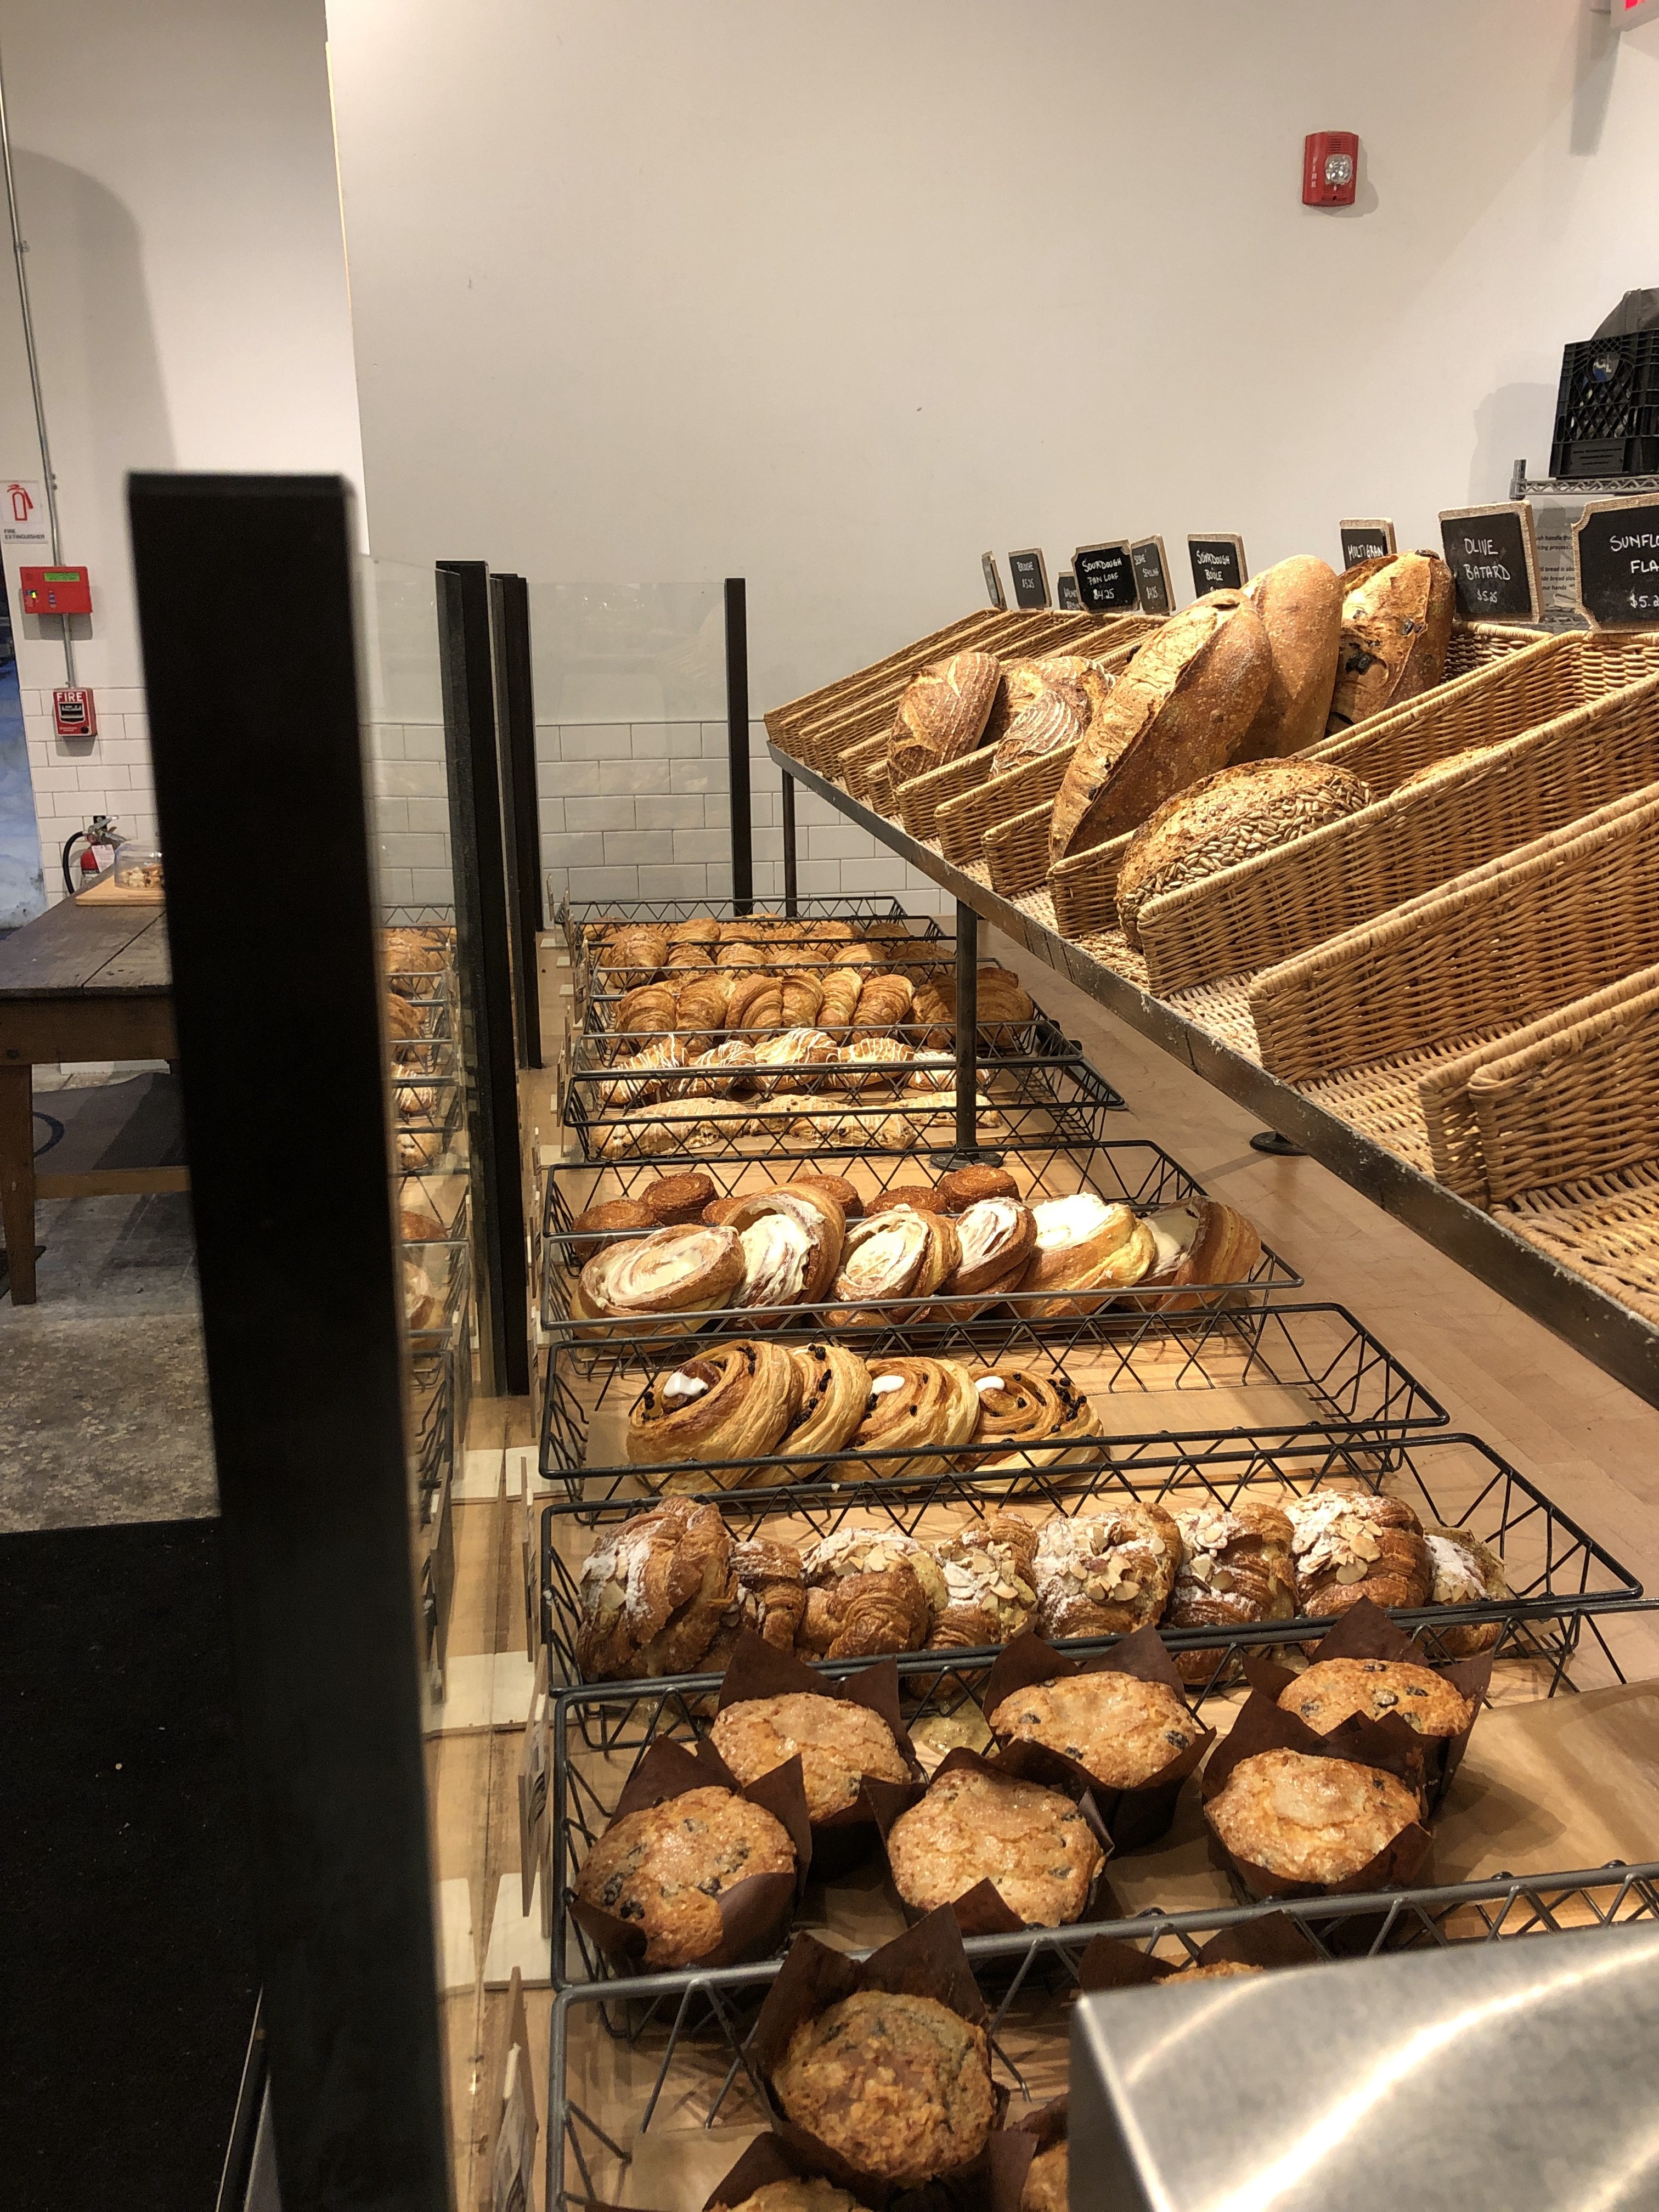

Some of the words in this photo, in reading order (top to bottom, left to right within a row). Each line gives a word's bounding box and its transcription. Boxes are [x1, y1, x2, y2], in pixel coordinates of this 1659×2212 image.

[1464, 538, 1498, 556] OLIVE
[1082, 557, 1122, 572] SOURDOUGH
[1197, 550, 1229, 565] SOURDOUGH
[1103, 572, 1119, 582] LOAF
[1463, 563, 1510, 580] BATARD
[56, 692, 83, 702] FIRE
